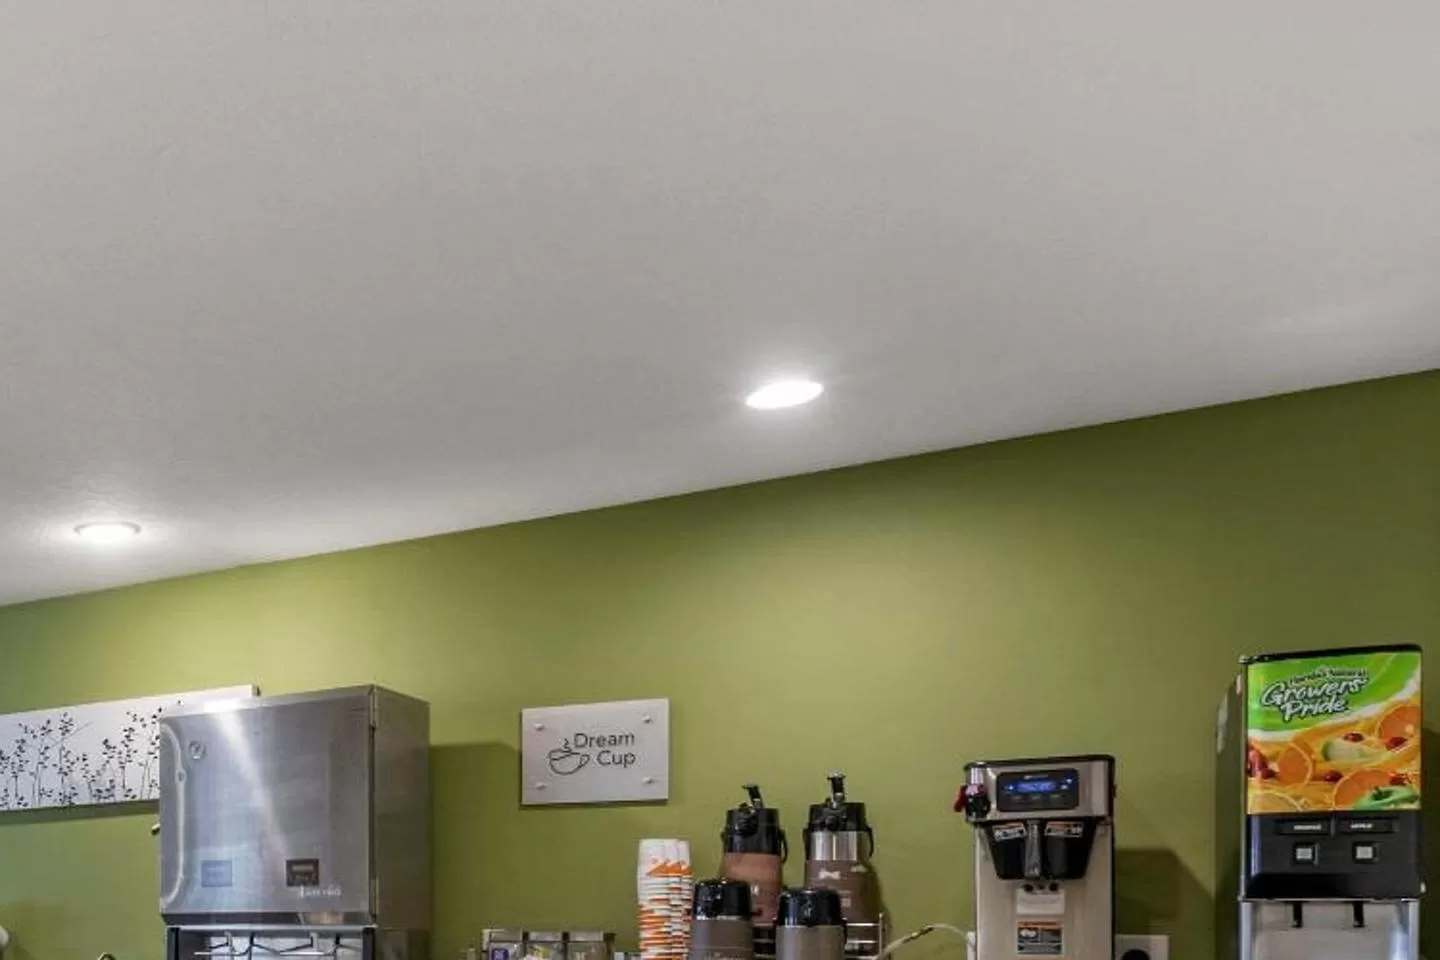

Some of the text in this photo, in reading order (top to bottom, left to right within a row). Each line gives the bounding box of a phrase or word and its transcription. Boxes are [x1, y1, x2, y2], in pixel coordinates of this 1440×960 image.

[1280, 694, 1346, 722] Pride
[573, 732, 635, 748] Dream
[596, 749, 637, 769] Cup
